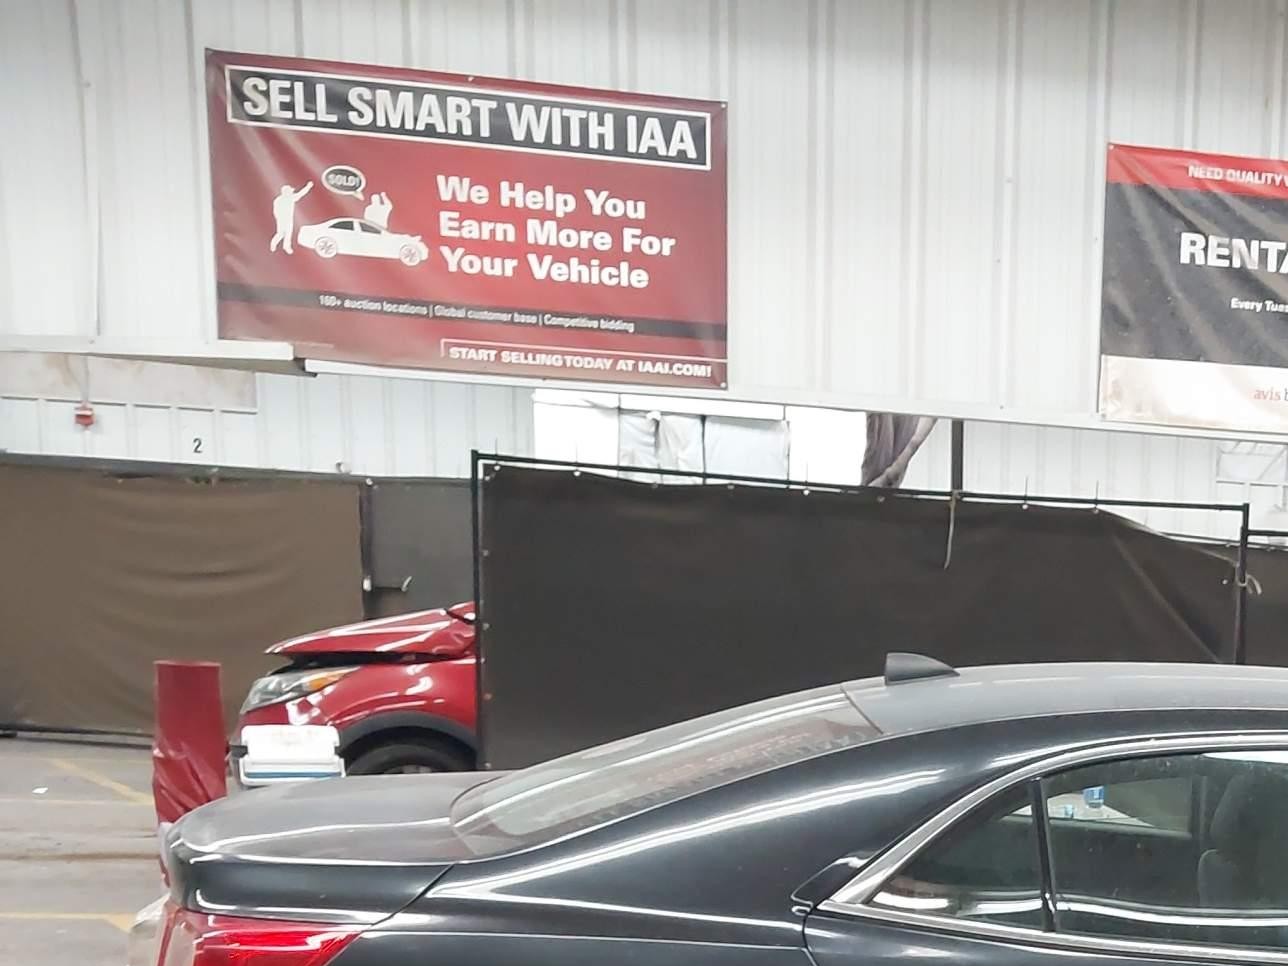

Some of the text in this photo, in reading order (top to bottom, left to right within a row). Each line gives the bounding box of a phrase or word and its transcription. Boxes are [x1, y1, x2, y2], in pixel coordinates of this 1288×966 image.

[242, 76, 698, 159] SELL SMART WITH IAA
[1188, 165, 1223, 180] NEED
[1226, 168, 1282, 186] QUALITY
[436, 174, 646, 220] We Help You
[439, 210, 677, 256] Earn More For
[439, 245, 649, 289] Your Vehicle
[343, 298, 382, 311] auction
[382, 301, 427, 315] locations
[434, 304, 466, 318] Global
[467, 309, 512, 322] customer
[513, 311, 537, 324] base
[543, 314, 598, 329] Competitive
[600, 319, 635, 333] bidding
[1230, 297, 1263, 313] Every
[449, 347, 713, 378] START SELLING TODAY AT IAAI.COM!
[1254, 387, 1281, 400] avis
[193, 437, 202, 454] 2
